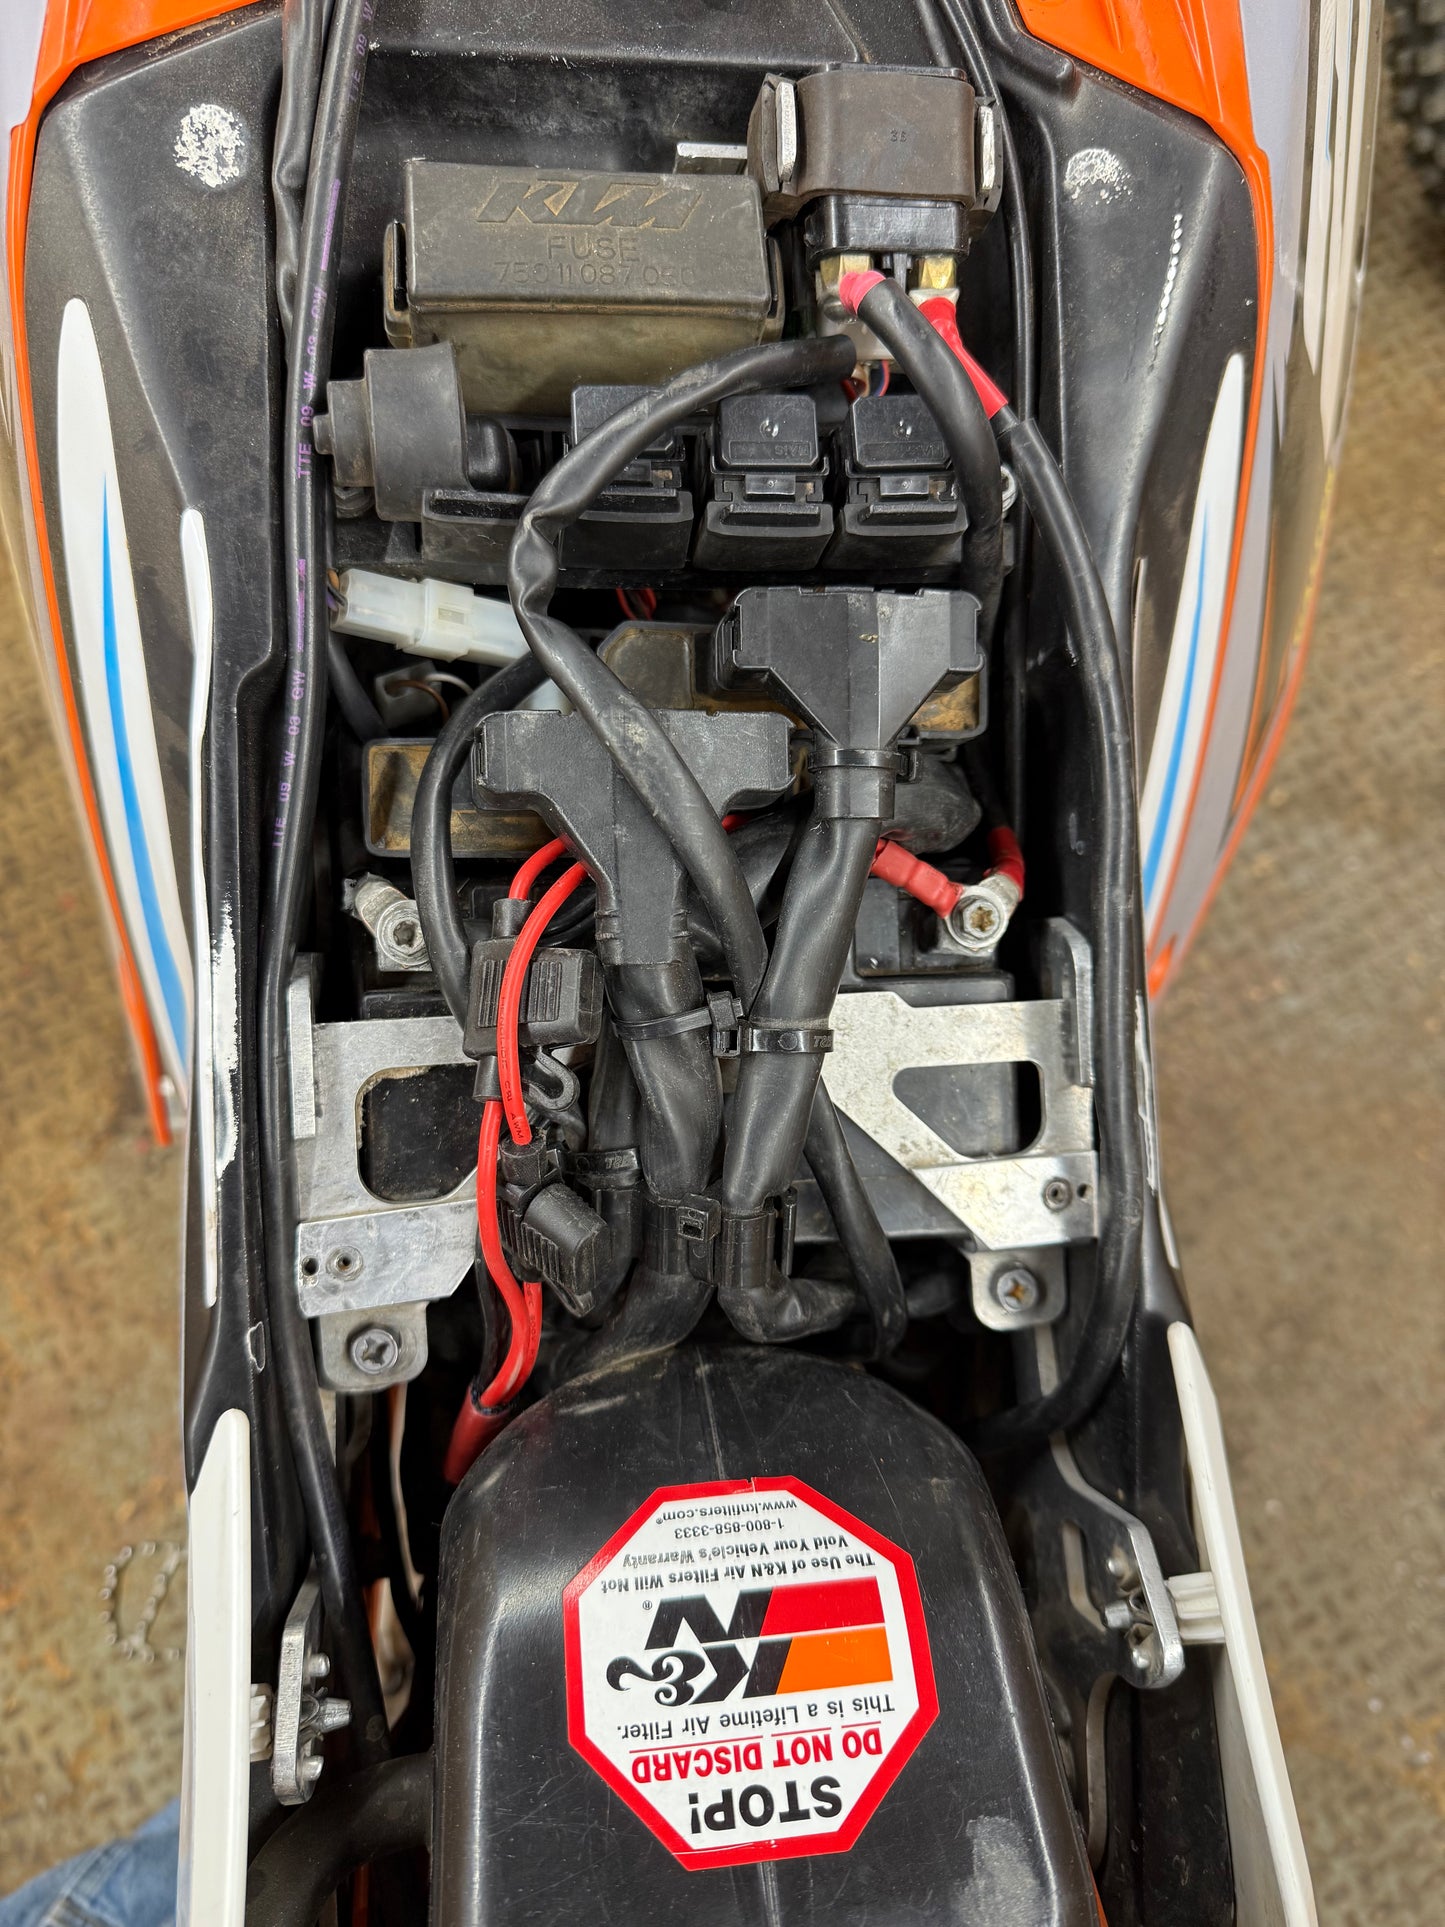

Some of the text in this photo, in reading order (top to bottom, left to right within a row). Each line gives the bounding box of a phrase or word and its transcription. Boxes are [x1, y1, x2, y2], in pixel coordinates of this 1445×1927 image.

[475, 178, 704, 231] KTM
[547, 235, 641, 262] FUSE
[302, 370, 317, 389] W
[300, 405, 315, 427] 09
[297, 442, 313, 479] TTE
[283, 750, 297, 767] W
[510, 1112, 524, 1139] AWM
[674, 1517, 784, 1539] 1-800-858-3333
[622, 1534, 848, 1569] Void Your Vehicle's Warranty
[601, 1552, 875, 1594] The Use of K&N Air Filters Will Not
[617, 1694, 895, 1740] This is a Lifetime Air Filter.
[632, 1728, 882, 1784] DO NOT DISCARD
[688, 1776, 842, 1834] STOP!
